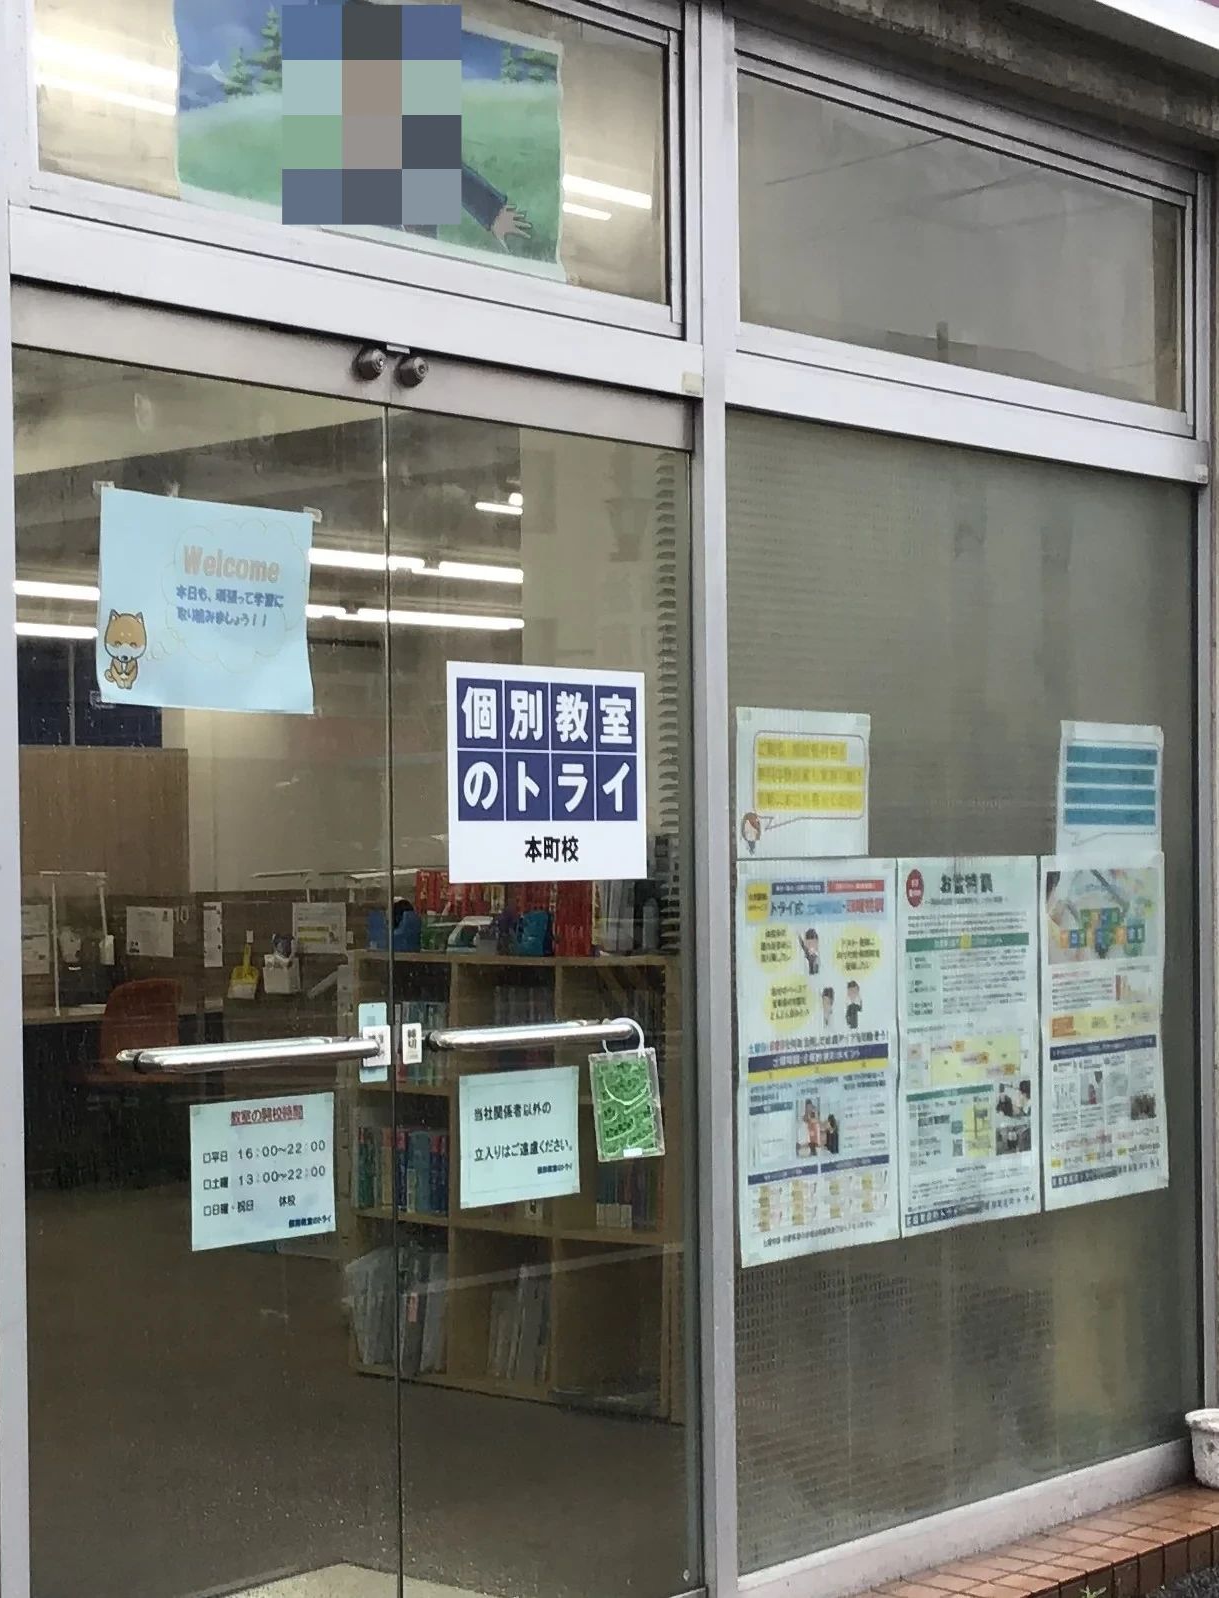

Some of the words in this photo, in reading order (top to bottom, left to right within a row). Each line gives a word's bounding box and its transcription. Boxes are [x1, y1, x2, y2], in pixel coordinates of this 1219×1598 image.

[183, 544, 280, 583] Welcome
[524, 835, 579, 863] 本町校
[474, 1101, 552, 1122] 当社関係者以外の
